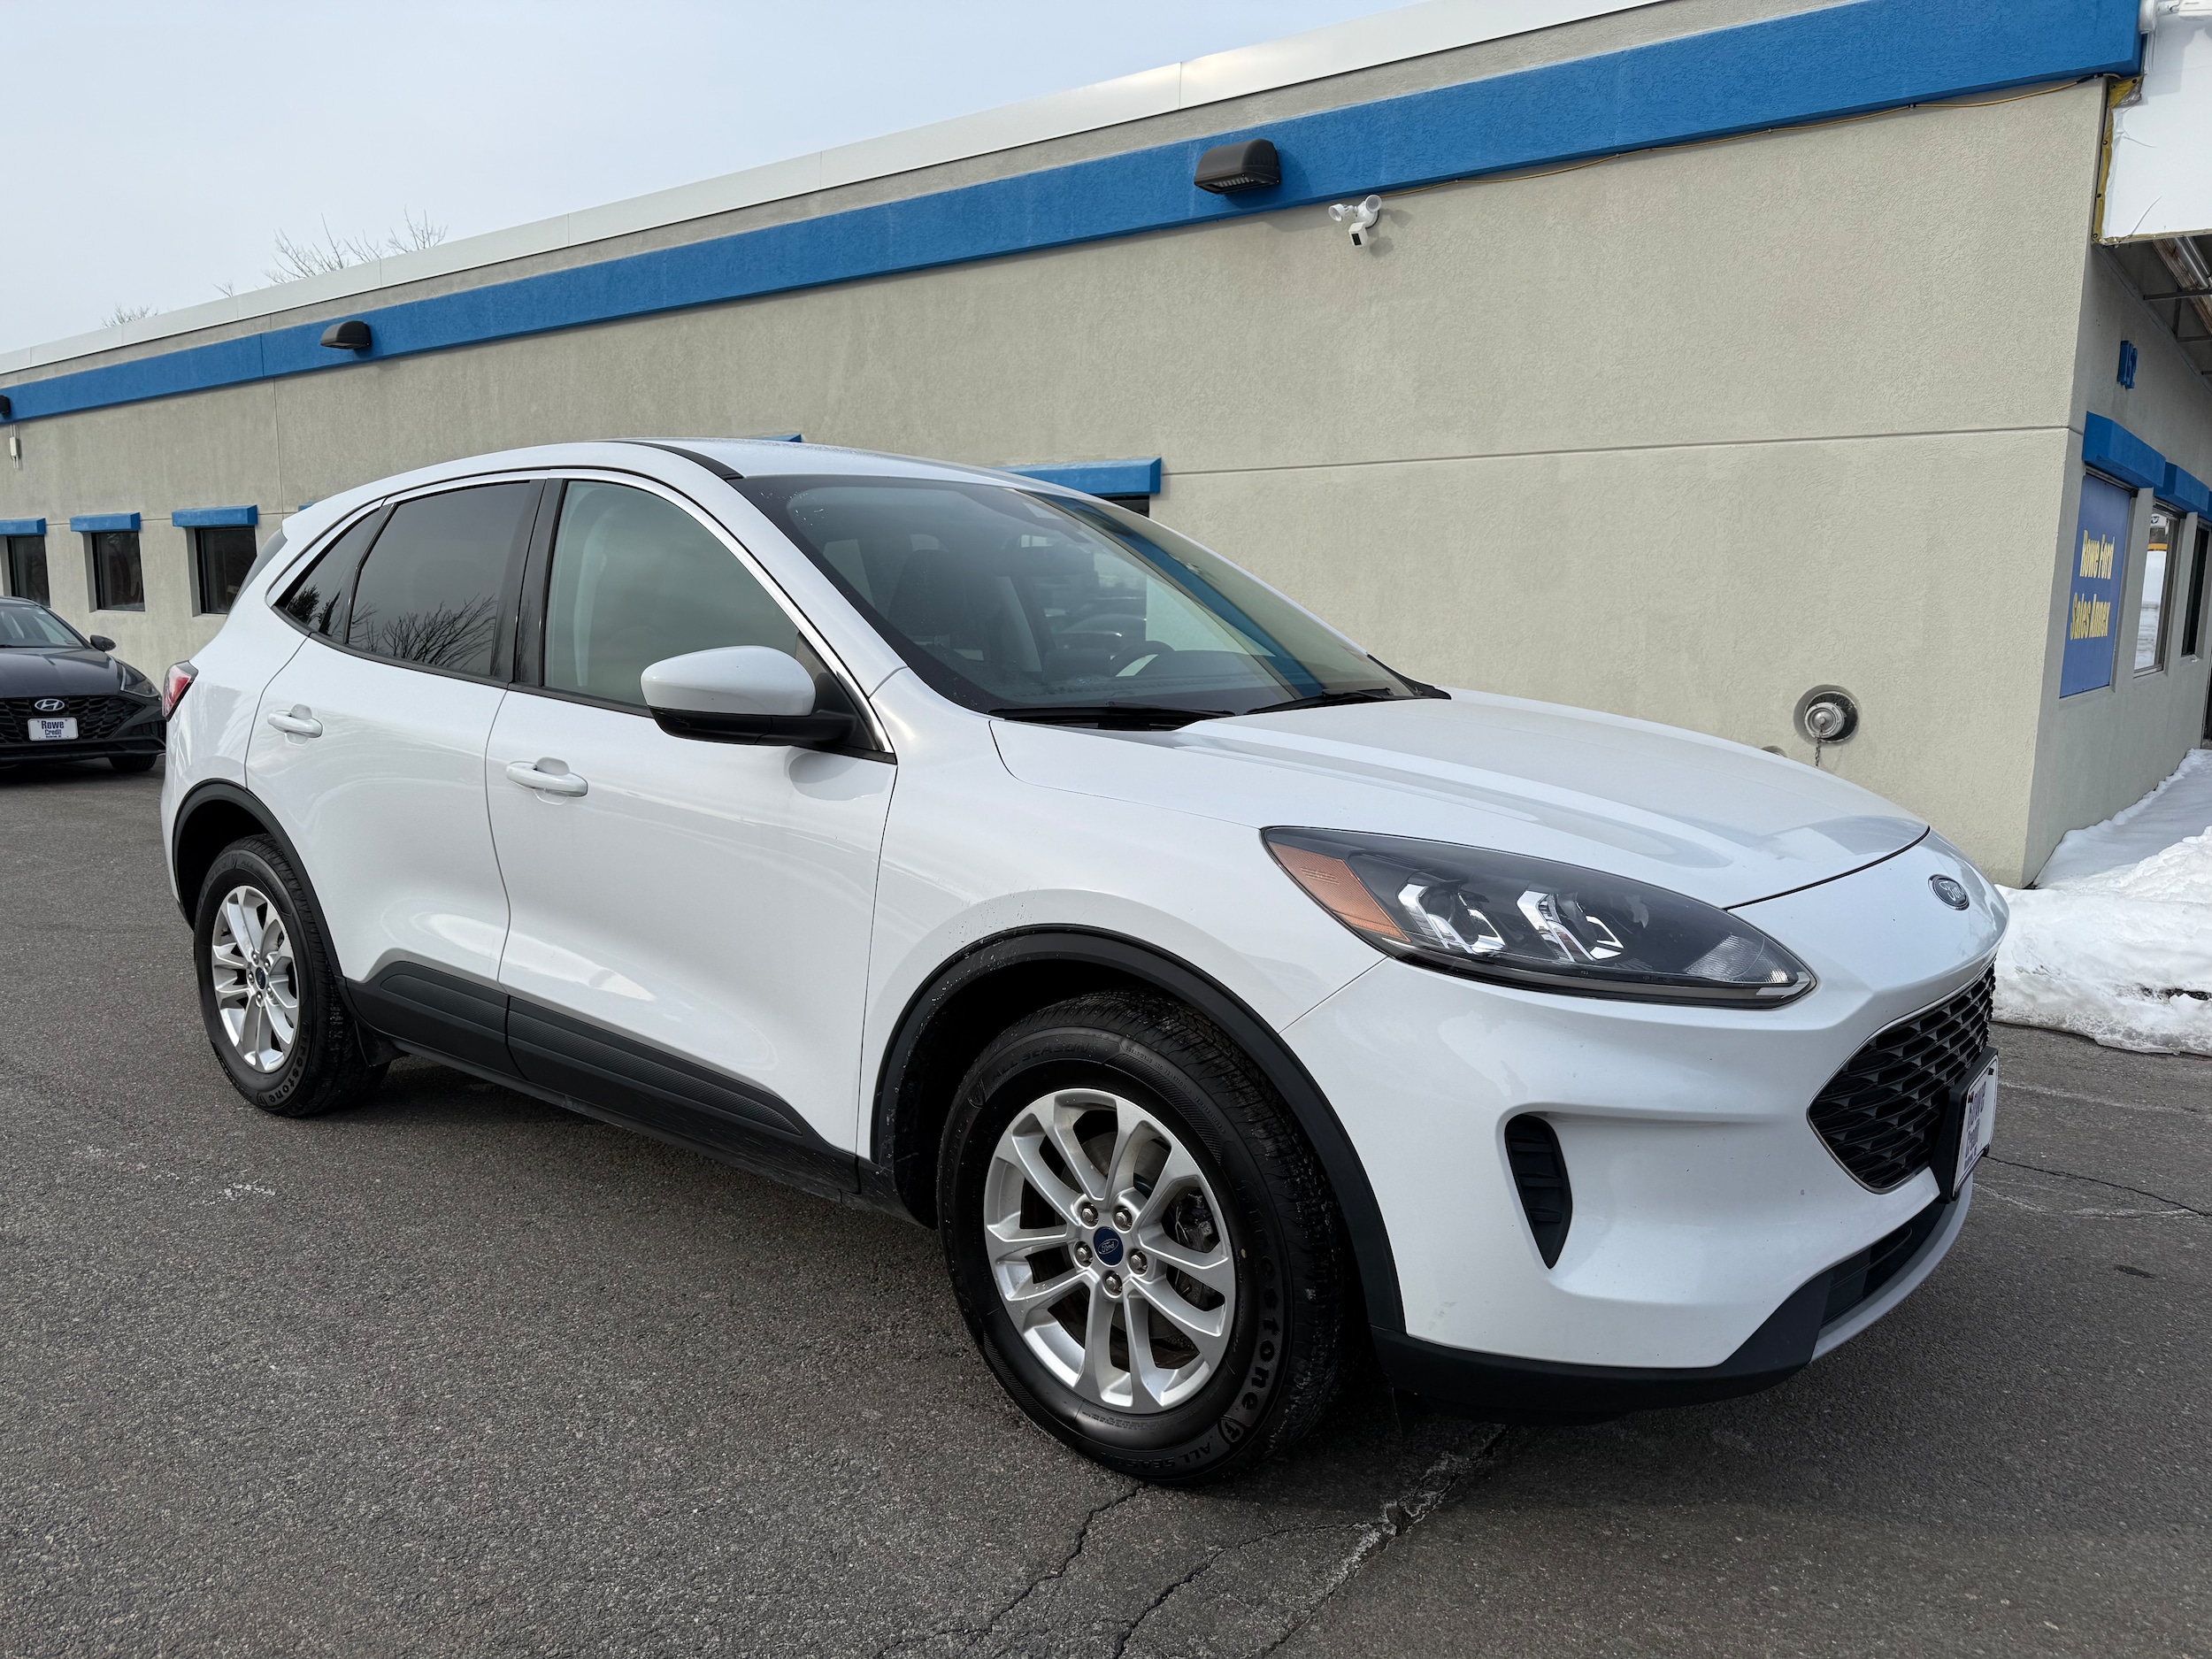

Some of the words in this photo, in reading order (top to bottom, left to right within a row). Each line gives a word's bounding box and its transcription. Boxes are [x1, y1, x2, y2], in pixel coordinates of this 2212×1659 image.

[2079, 529, 2101, 578] Rowe
[2097, 534, 2116, 580] Ford
[2070, 592, 2092, 641] Sales
[41, 720, 65, 730] Rowe
[1939, 880, 1964, 902] Ford
[1101, 1240, 1116, 1253] Ford
[1178, 1443, 1210, 1463] ALL
